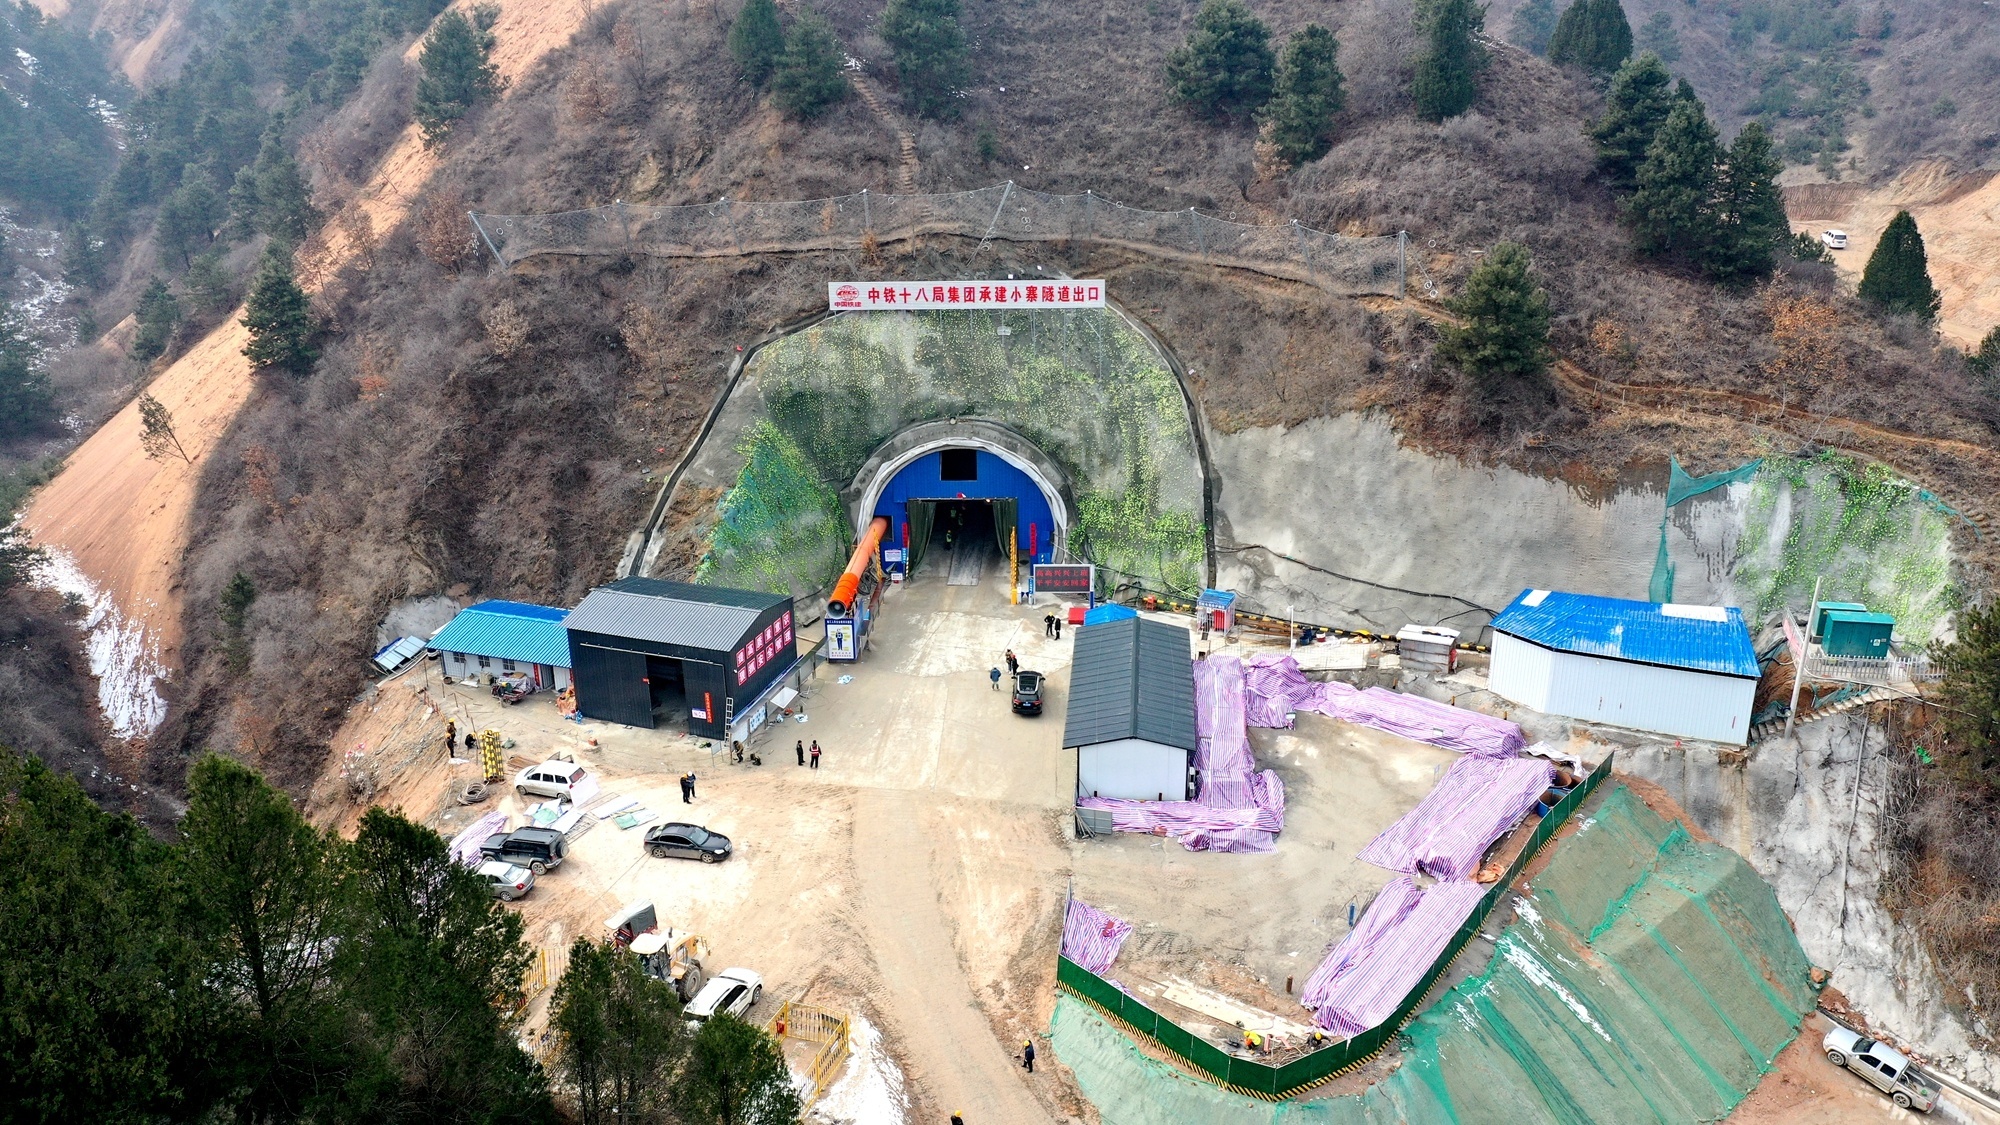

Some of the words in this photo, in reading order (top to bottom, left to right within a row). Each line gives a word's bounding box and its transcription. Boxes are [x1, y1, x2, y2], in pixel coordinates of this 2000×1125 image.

[868, 285, 1099, 304] 中铁十八局集团承建小寨隧道出口
[1036, 569, 1088, 577] 高高兴兴上班
[1036, 579, 1088, 587] 平平安安回家
